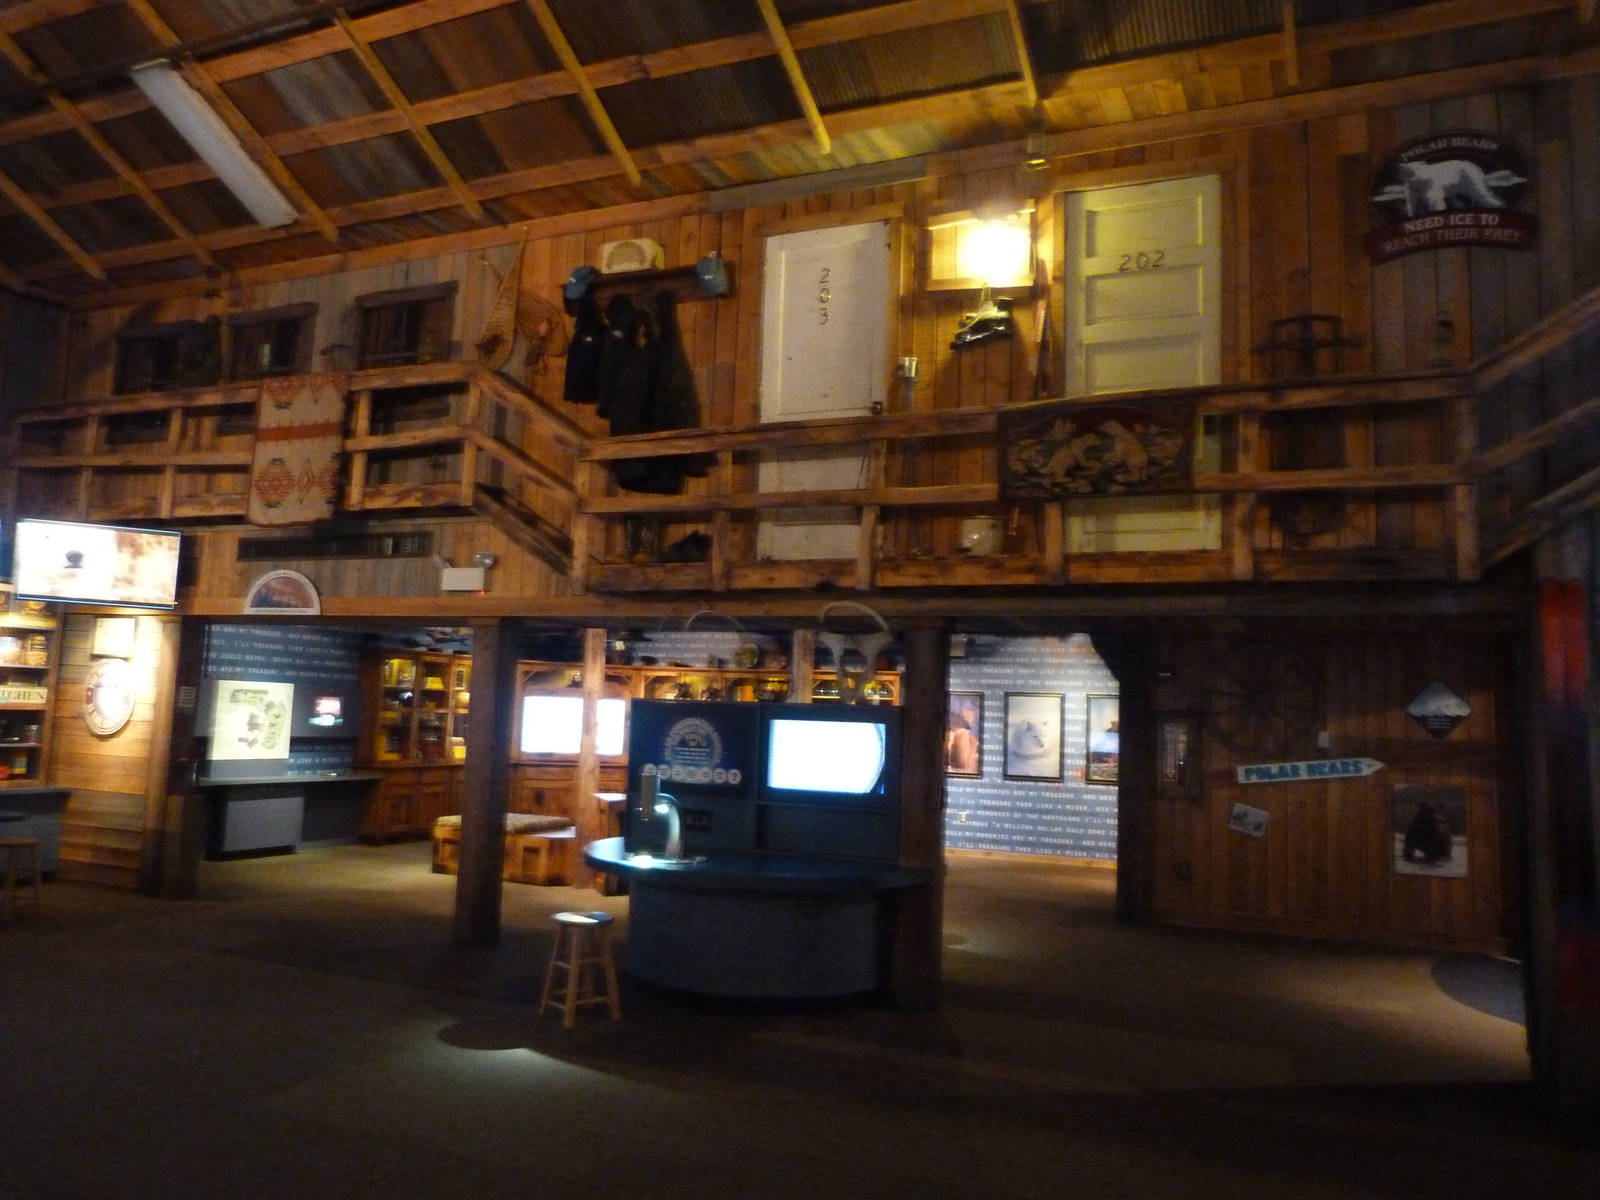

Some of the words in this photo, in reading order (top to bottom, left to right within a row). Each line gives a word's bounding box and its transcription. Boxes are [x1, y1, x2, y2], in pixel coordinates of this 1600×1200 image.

[1404, 216, 1445, 233] NEED
[1450, 213, 1474, 226] ICE
[1479, 213, 1500, 226] TO
[1383, 233, 1431, 254] REACH
[1436, 229, 1478, 242] THEIR
[1483, 230, 1521, 242] PREY
[1119, 250, 1166, 272] 202
[819, 267, 832, 325] 203
[1244, 764, 1300, 781] POLAR
[1306, 761, 1364, 778] BEARS
